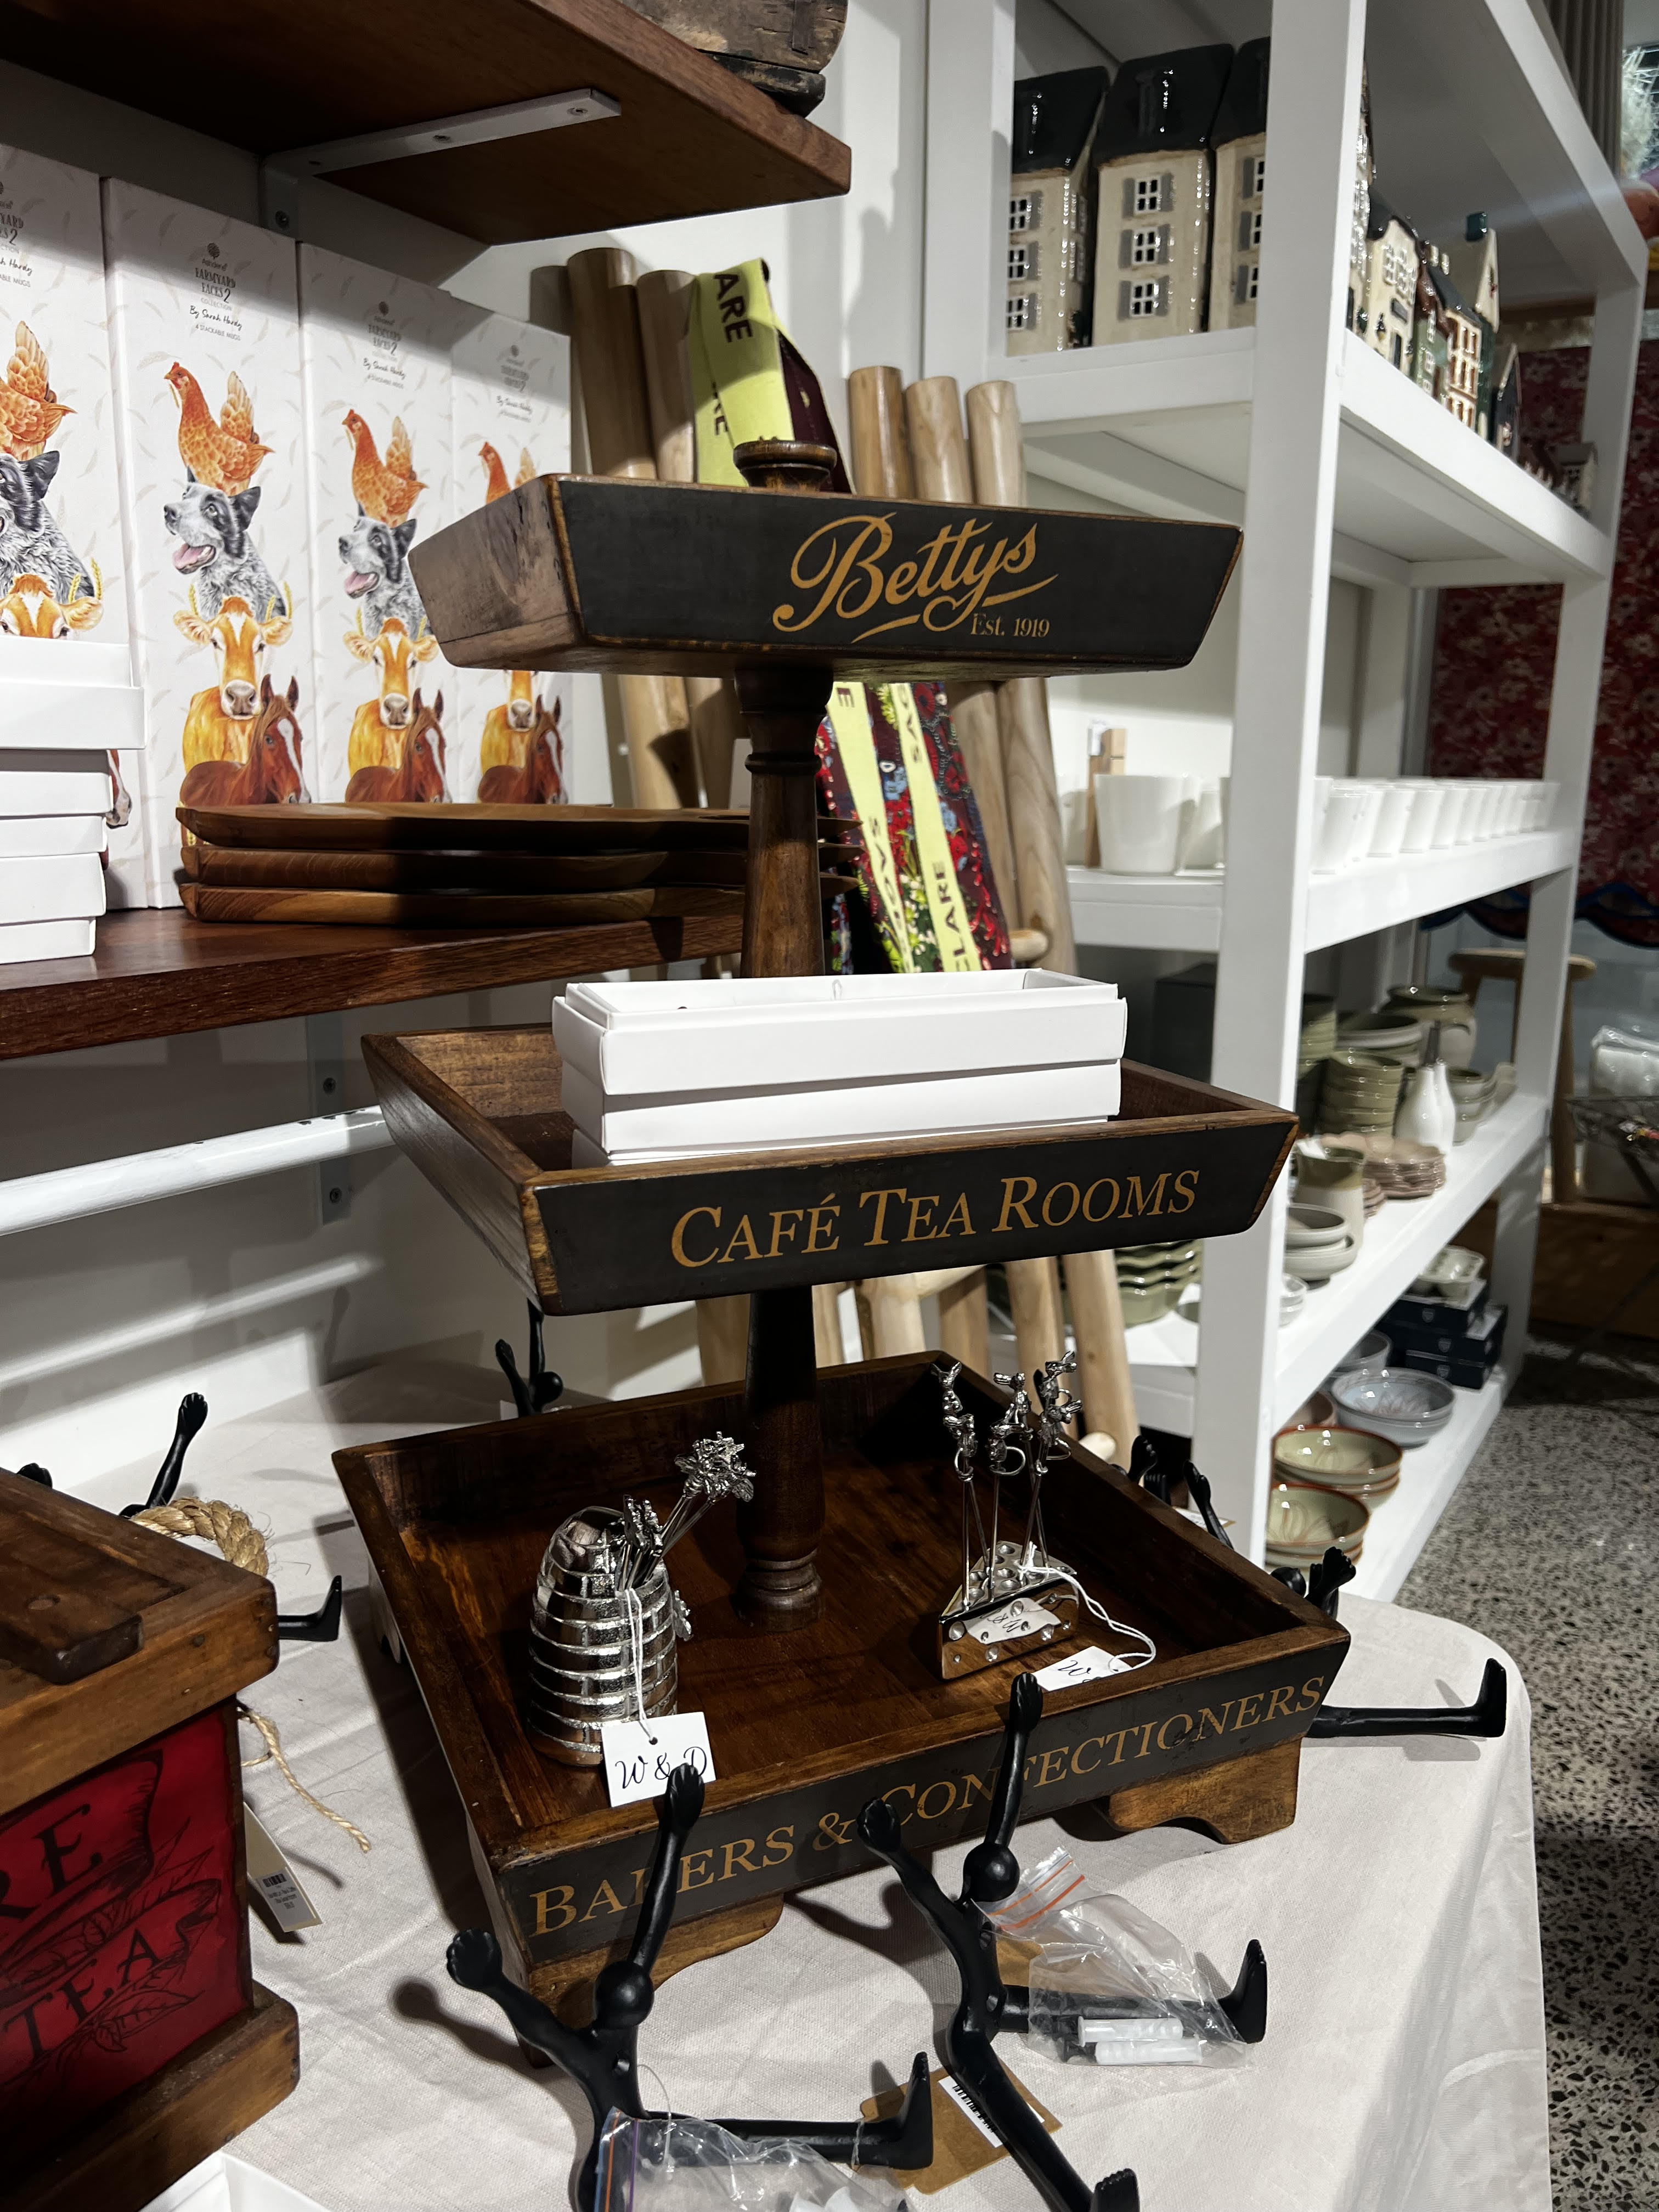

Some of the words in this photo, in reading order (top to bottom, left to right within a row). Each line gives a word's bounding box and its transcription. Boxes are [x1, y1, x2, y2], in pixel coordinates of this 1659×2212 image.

[190, 305, 200, 319] By
[224, 288, 231, 303] 2
[772, 512, 1059, 644] Bettys
[970, 613, 1005, 636] Est.
[1014, 617, 1050, 637] 1919
[671, 1193, 840, 1268] CAFÉ
[859, 1188, 976, 1246] TEA
[992, 1169, 1199, 1232] ROOMS
[614, 1755, 648, 1789] W
[654, 1752, 671, 1780] &
[812, 1812, 856, 1851] &
